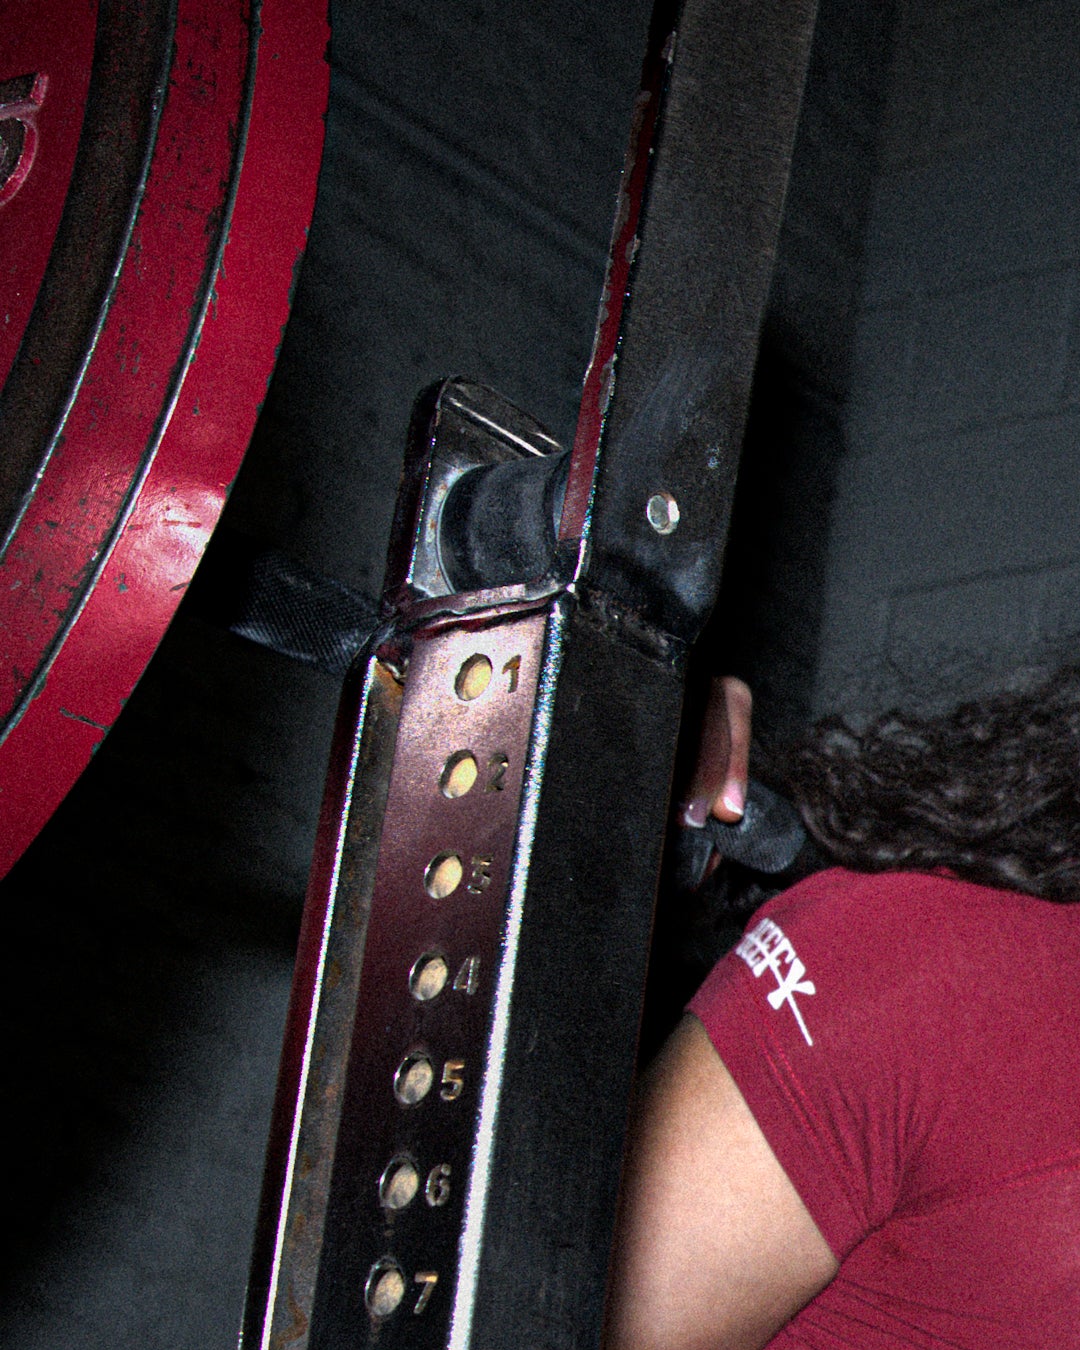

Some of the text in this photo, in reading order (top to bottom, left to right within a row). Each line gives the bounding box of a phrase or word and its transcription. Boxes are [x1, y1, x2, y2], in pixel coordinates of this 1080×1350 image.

[502, 655, 522, 693] 1
[452, 955, 482, 996] 4
[440, 1058, 467, 1101] 5
[425, 1163, 452, 1208] 6
[412, 1271, 440, 1315] 7
